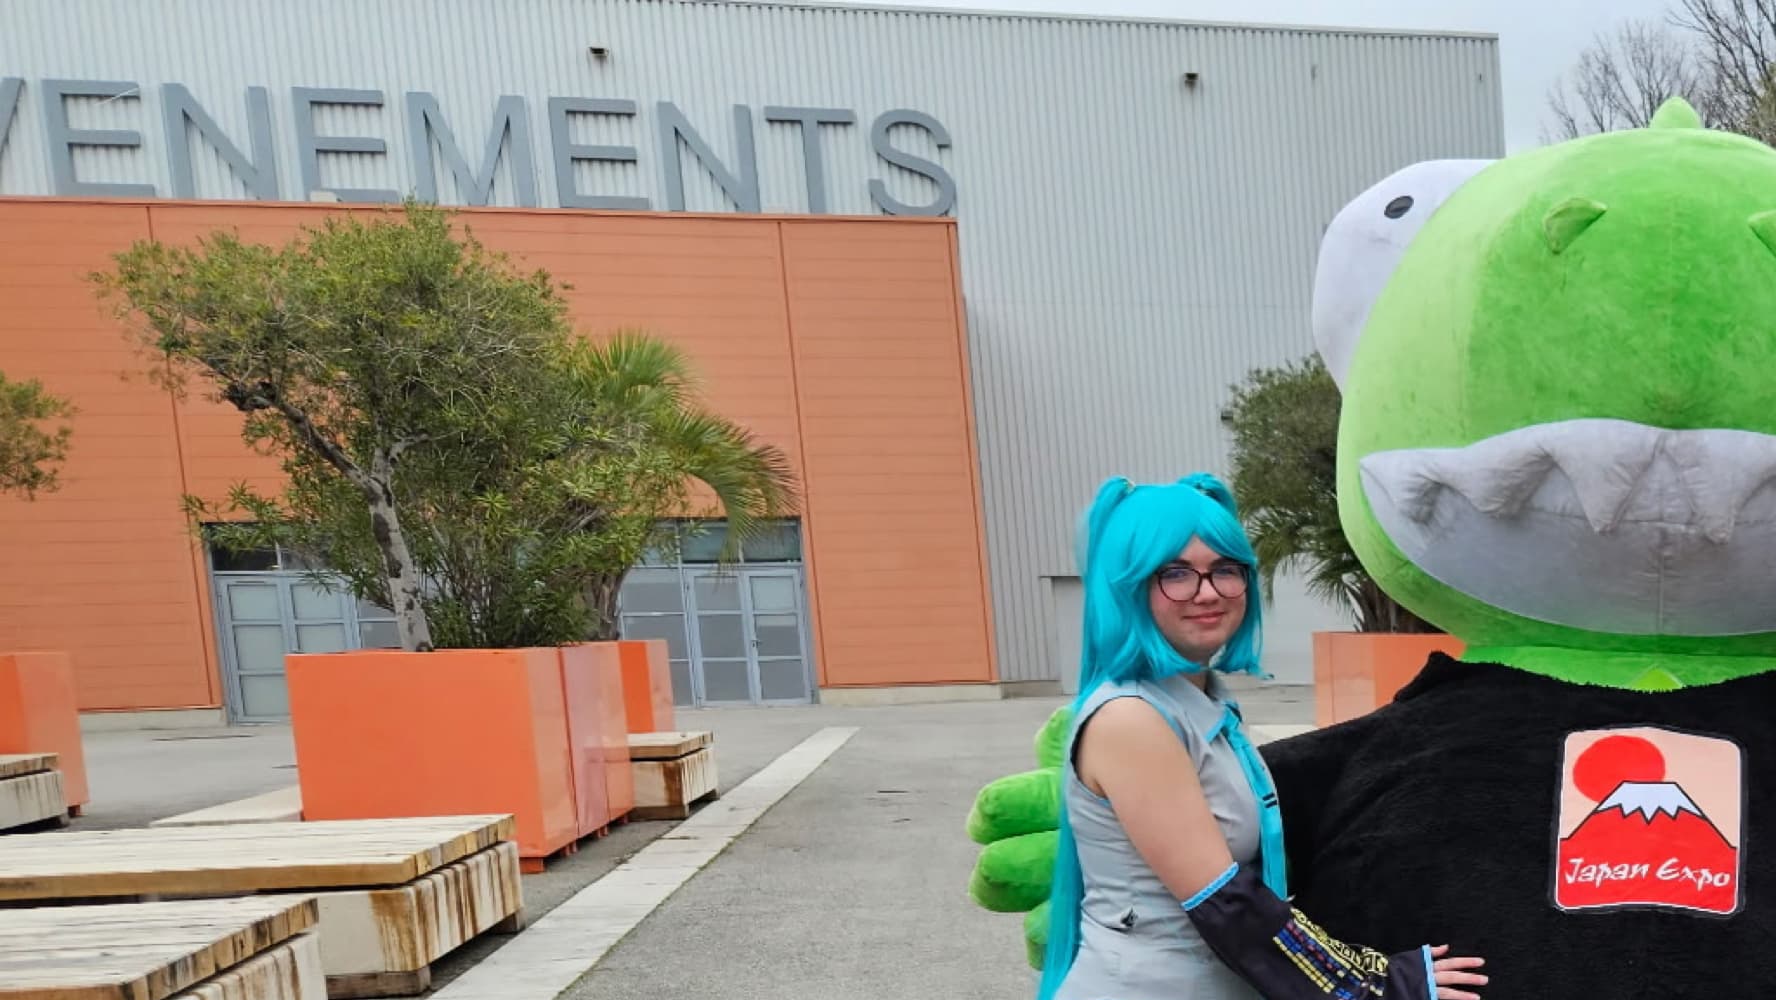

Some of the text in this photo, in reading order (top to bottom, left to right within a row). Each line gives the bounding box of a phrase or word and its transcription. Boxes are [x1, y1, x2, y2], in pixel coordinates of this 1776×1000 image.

[0, 77, 957, 217] ENEMENTS
[1565, 857, 1731, 891] Japan Expo
